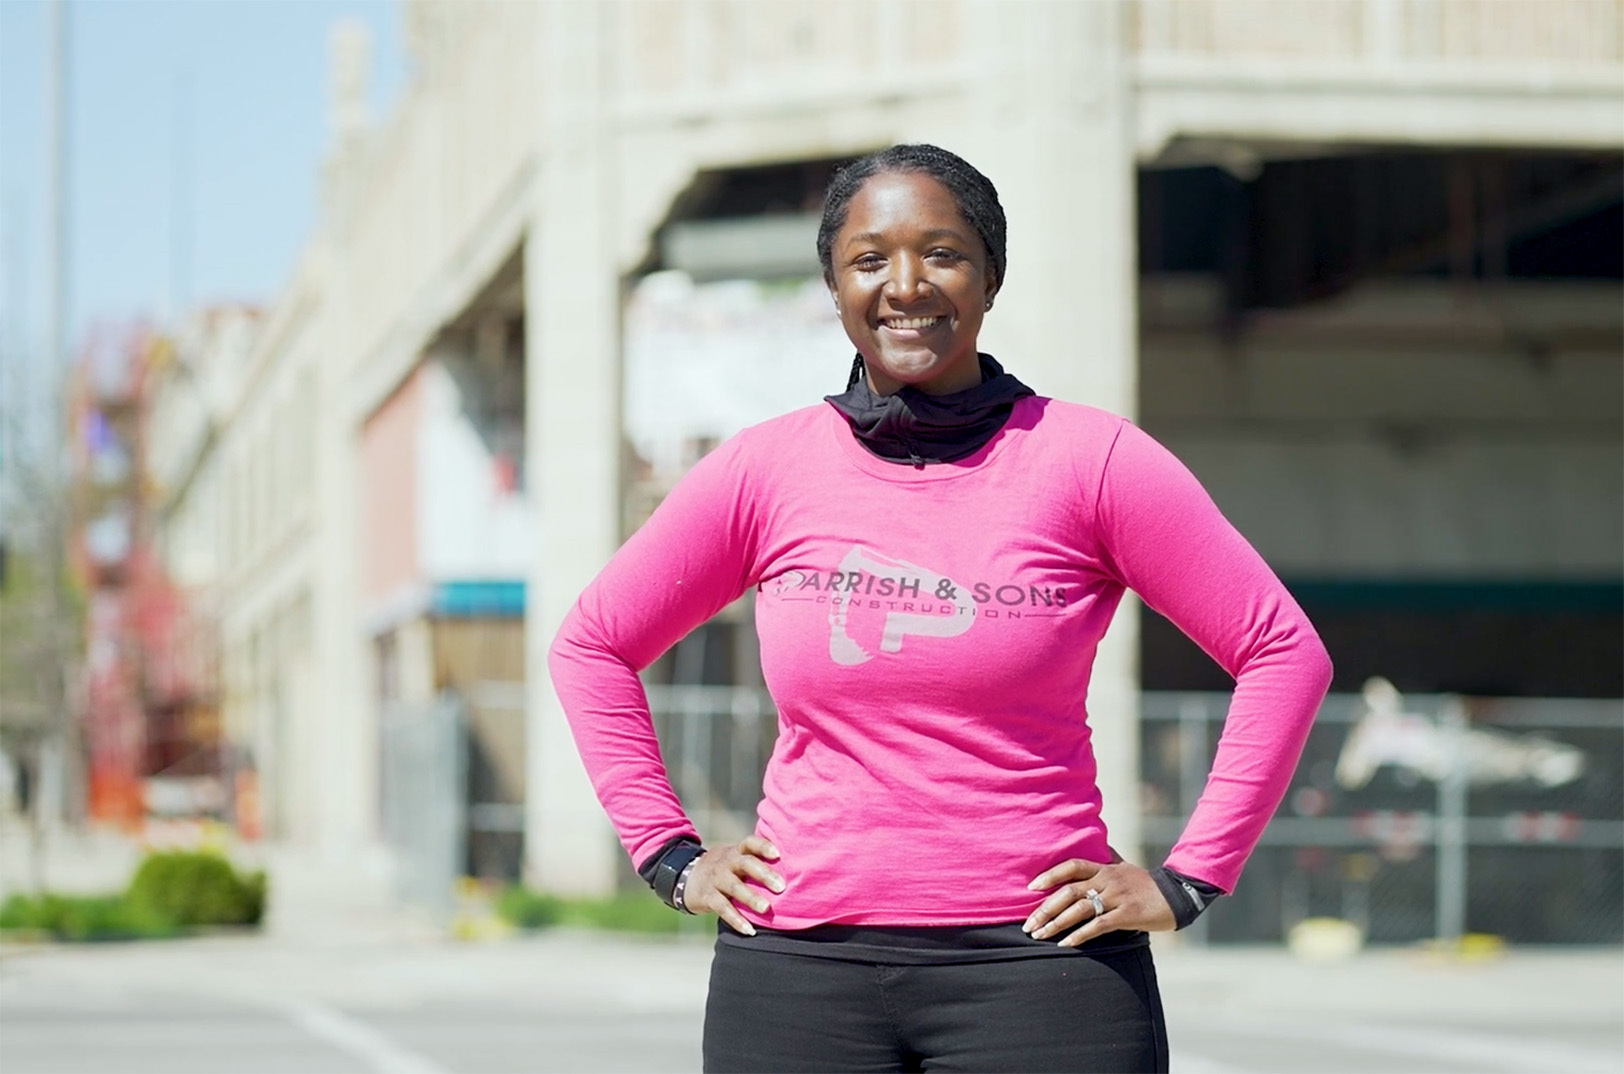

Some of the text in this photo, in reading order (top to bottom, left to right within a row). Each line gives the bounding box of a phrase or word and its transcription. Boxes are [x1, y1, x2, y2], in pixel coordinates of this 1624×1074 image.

[935, 578, 958, 600] &
[972, 583, 1067, 608] SONS
[816, 596, 1021, 619] CONSTRUCTION
